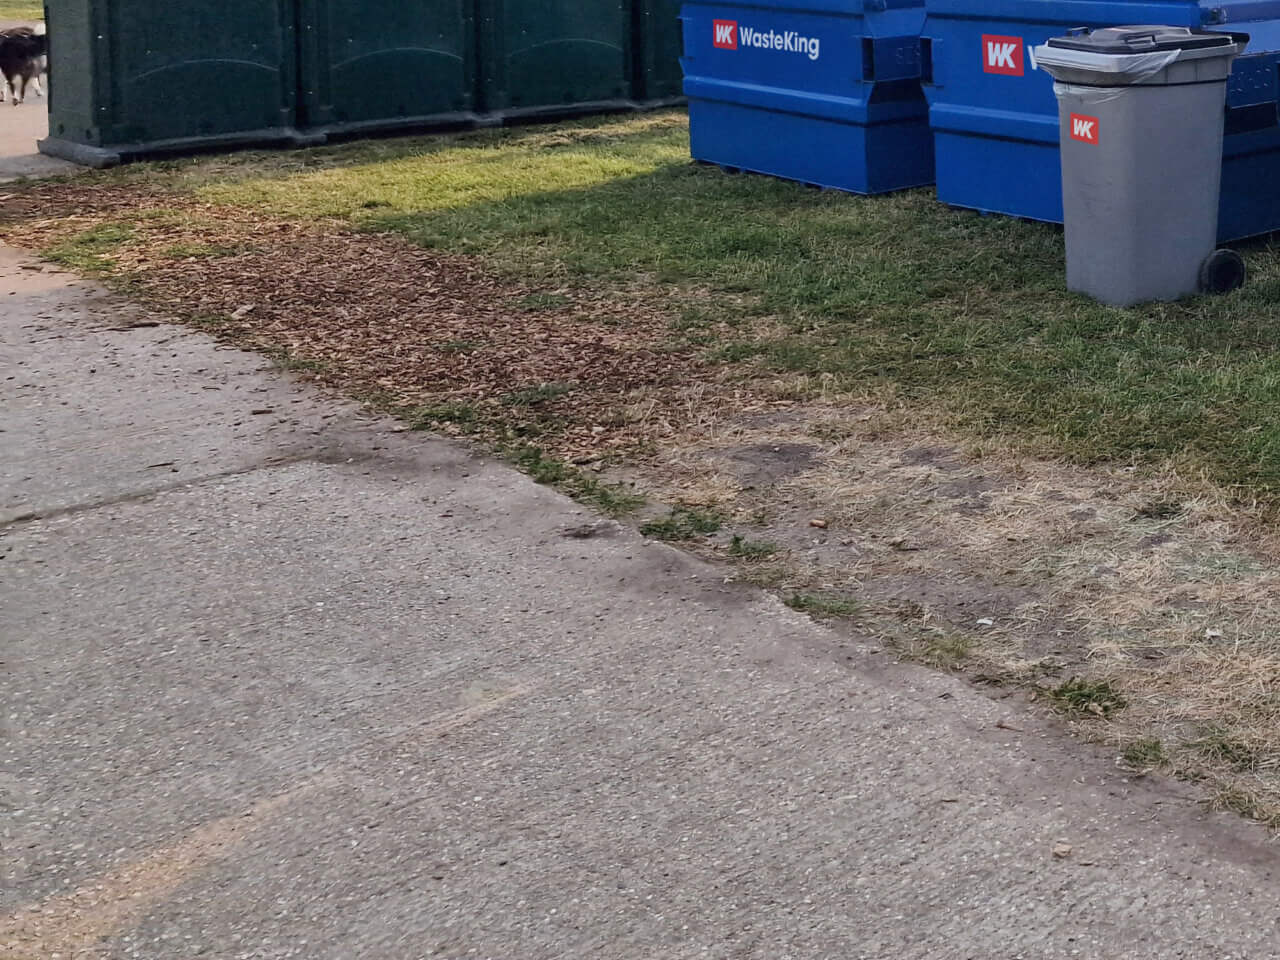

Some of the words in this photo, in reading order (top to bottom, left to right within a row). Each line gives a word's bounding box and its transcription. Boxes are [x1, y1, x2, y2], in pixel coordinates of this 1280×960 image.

[715, 23, 734, 44] WK
[739, 26, 820, 61] WasteKing
[987, 41, 1017, 69] WK
[1073, 118, 1095, 139] WK
